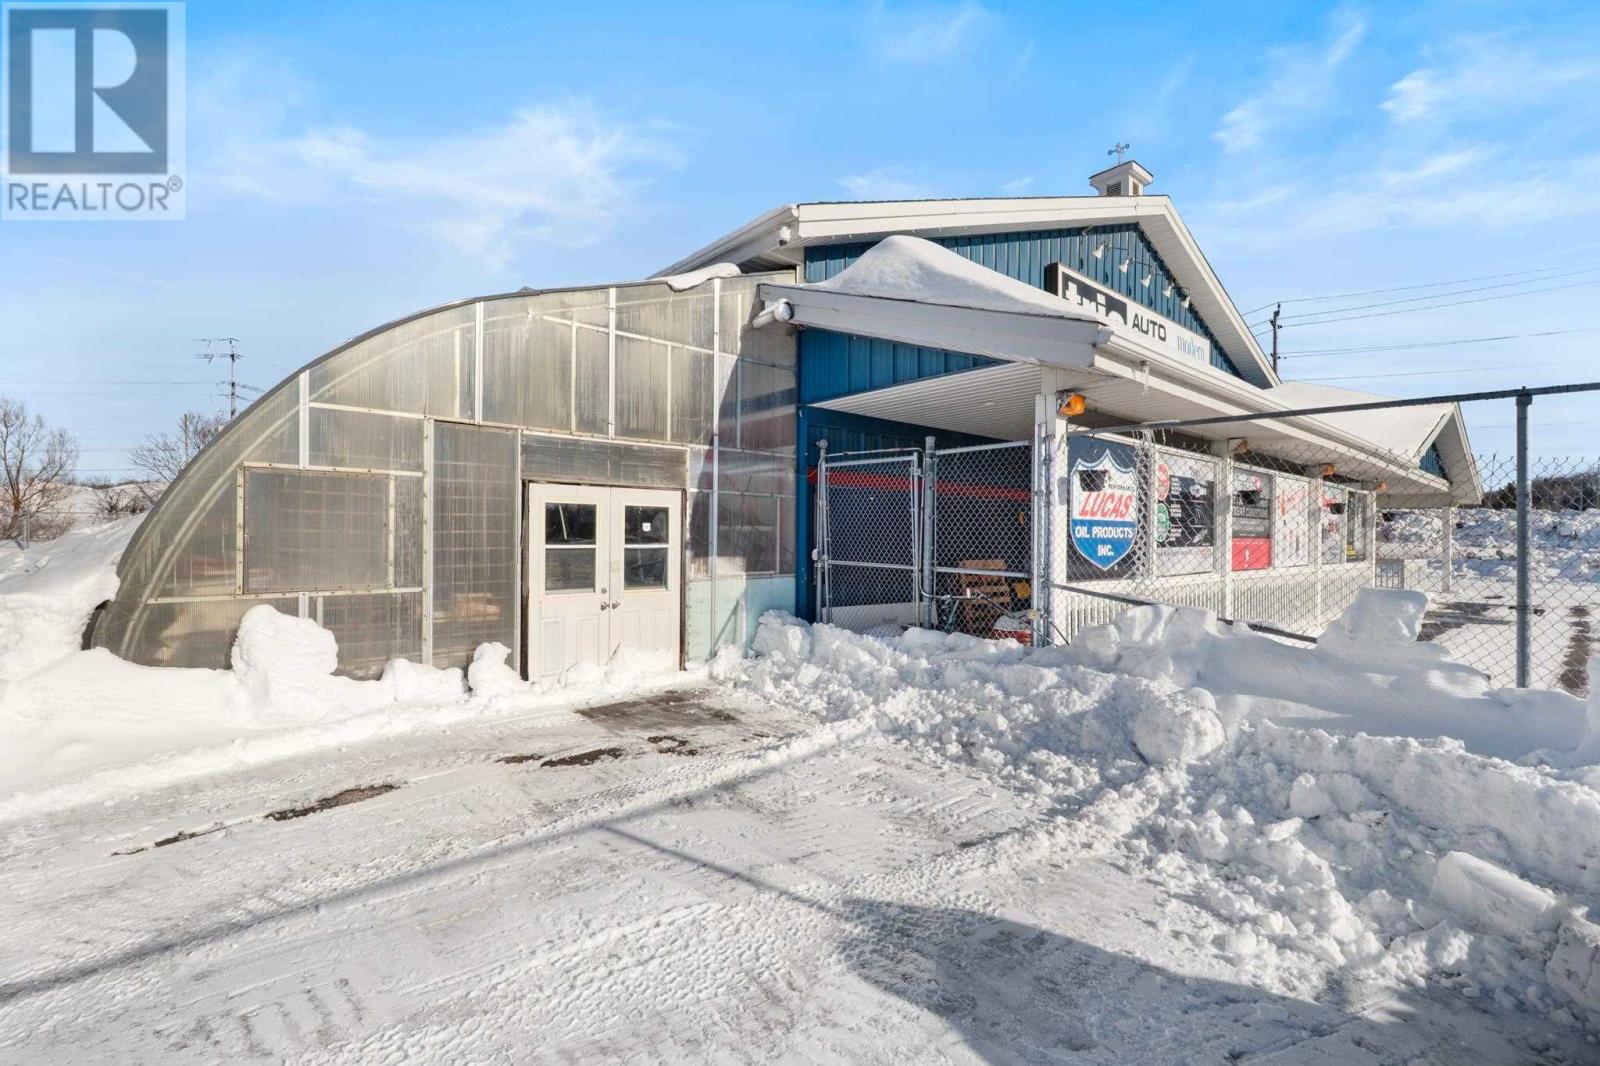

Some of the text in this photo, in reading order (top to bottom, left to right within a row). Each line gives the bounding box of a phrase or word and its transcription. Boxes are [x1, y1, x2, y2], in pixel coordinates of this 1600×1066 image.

[1132, 313, 1167, 342] AUTO
[1079, 491, 1134, 518] LUCAS
[1075, 525, 1134, 539] OIL PRODUCTS
[1097, 544, 1115, 557] INC.
